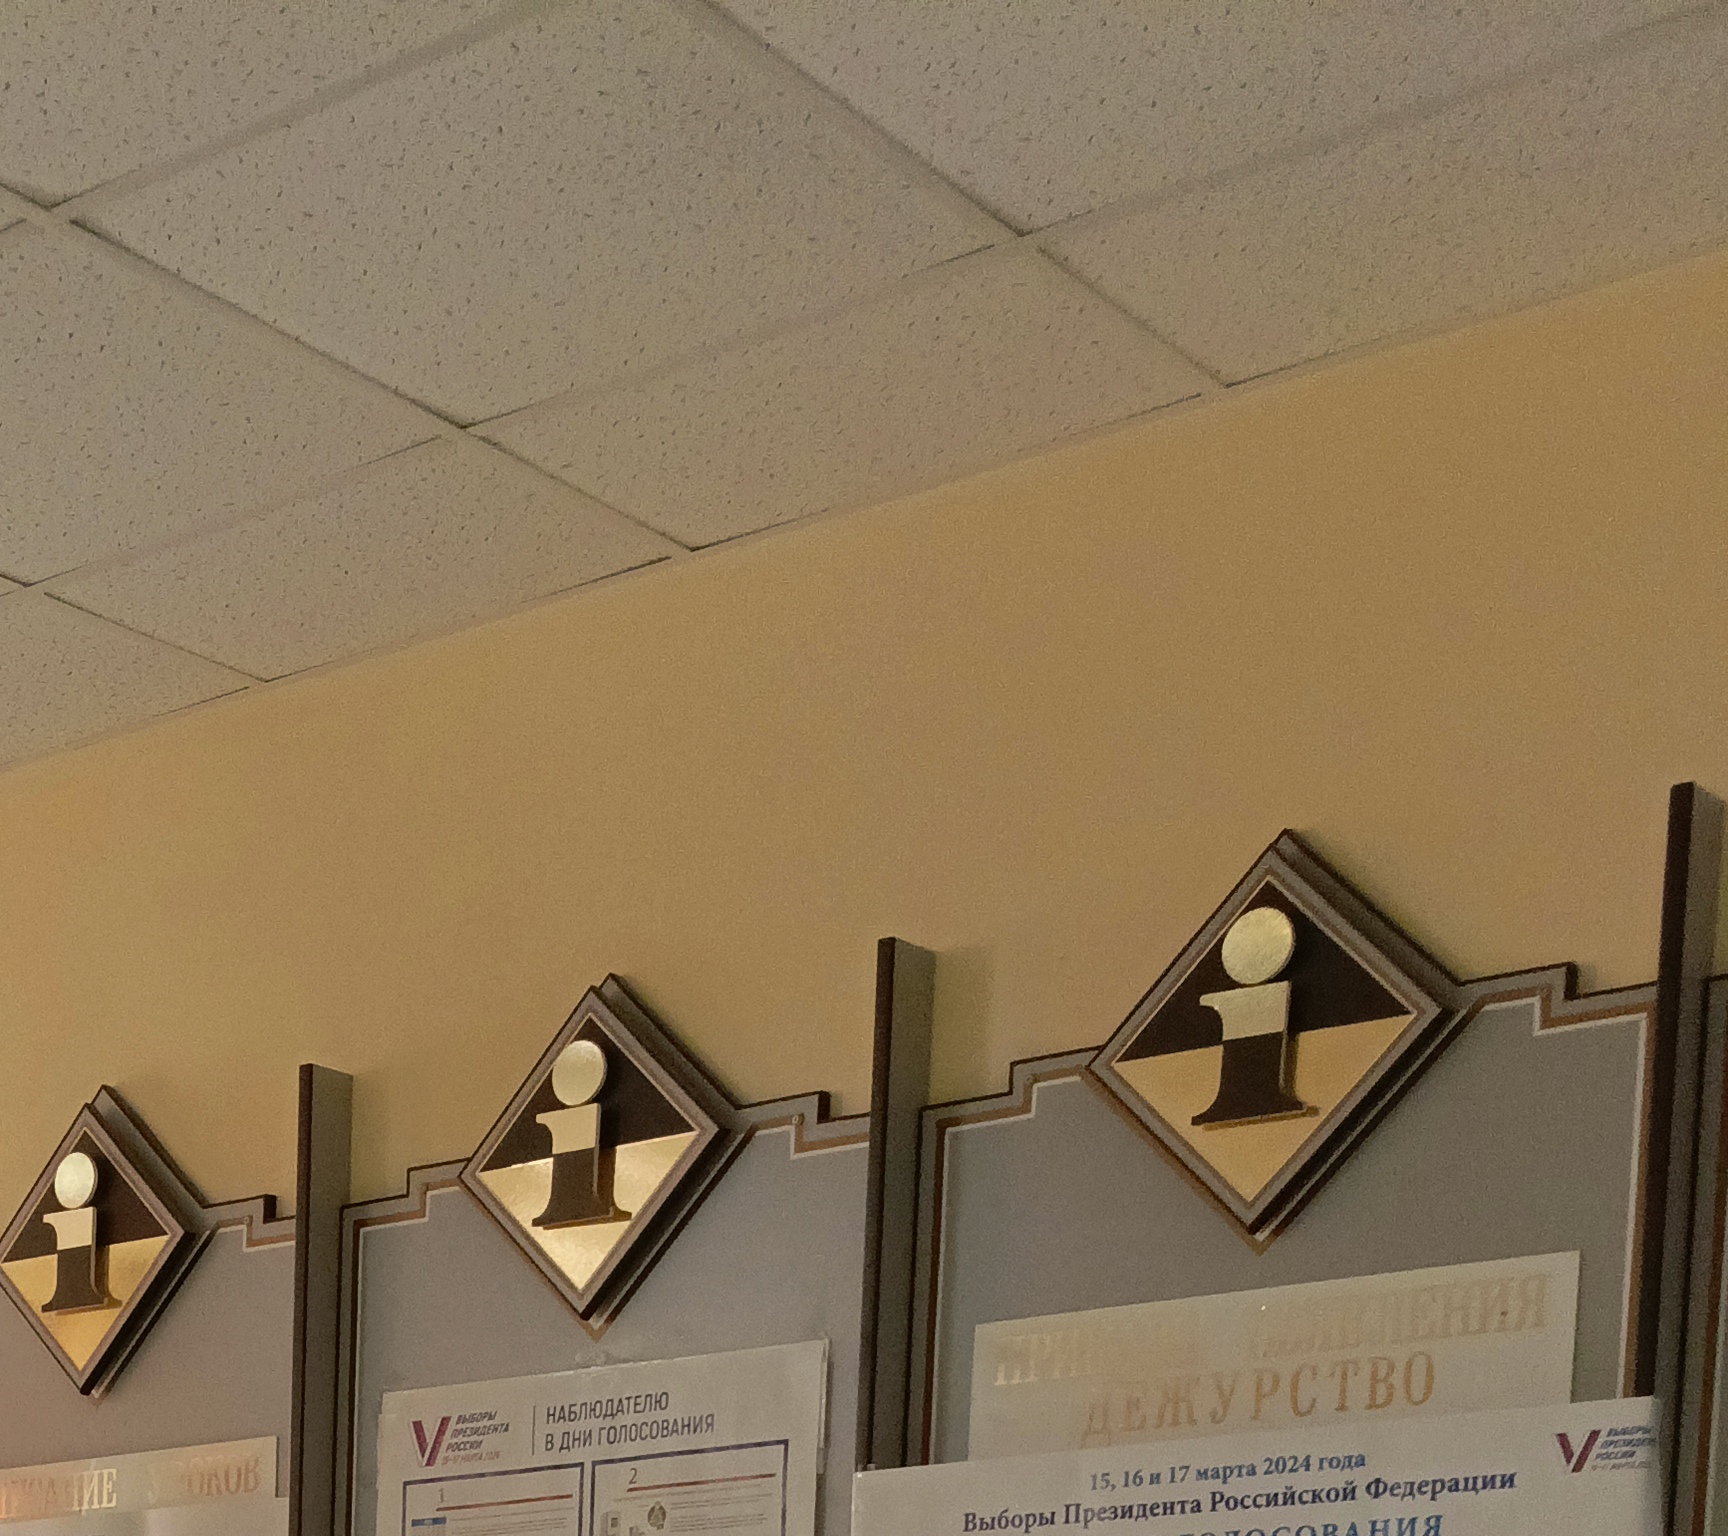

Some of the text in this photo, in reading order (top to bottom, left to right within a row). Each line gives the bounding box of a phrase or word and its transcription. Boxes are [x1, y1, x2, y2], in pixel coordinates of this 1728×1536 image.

[456, 1411, 497, 1425] ВЫБОРЫ
[546, 1391, 669, 1424] НАБЛЮДАТЕЛЮ
[1080, 1351, 1434, 1449] ДЕЖУРСТВО
[445, 1440, 483, 1453] РОССИИ
[451, 1422, 510, 1438] ПРЕЗИДЕНТА
[544, 1414, 715, 1453] В ДНИ ГОЛОСОВАНИЯ
[147, 1456, 261, 1503] УОКОВ
[628, 1467, 638, 1484] 2
[1090, 1453, 1366, 1494] 15, 16 и 17 марта 2024 года
[963, 1472, 1518, 1533] Выборы Президента Российской Федерации
